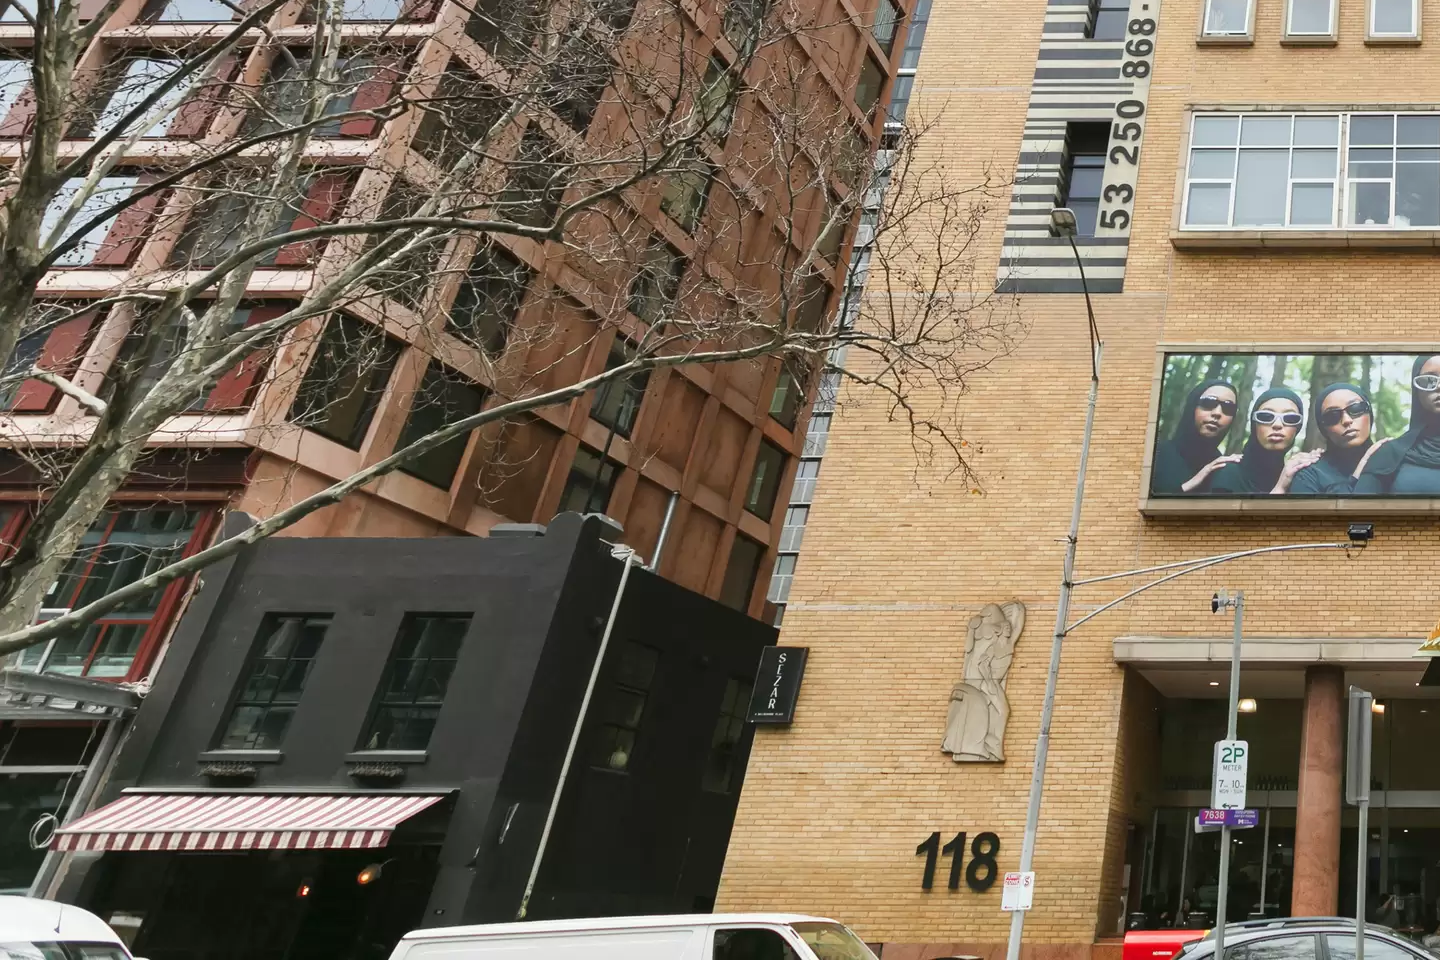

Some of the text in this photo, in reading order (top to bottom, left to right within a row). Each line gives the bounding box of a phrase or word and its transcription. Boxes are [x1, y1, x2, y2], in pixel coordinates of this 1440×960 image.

[1109, 99, 1145, 166] 250
[1100, 183, 1134, 230] 53
[768, 653, 787, 709] SEZAR
[1221, 747, 1245, 763] 2P
[1204, 810, 1225, 820] 7638
[916, 831, 1000, 893] 118
